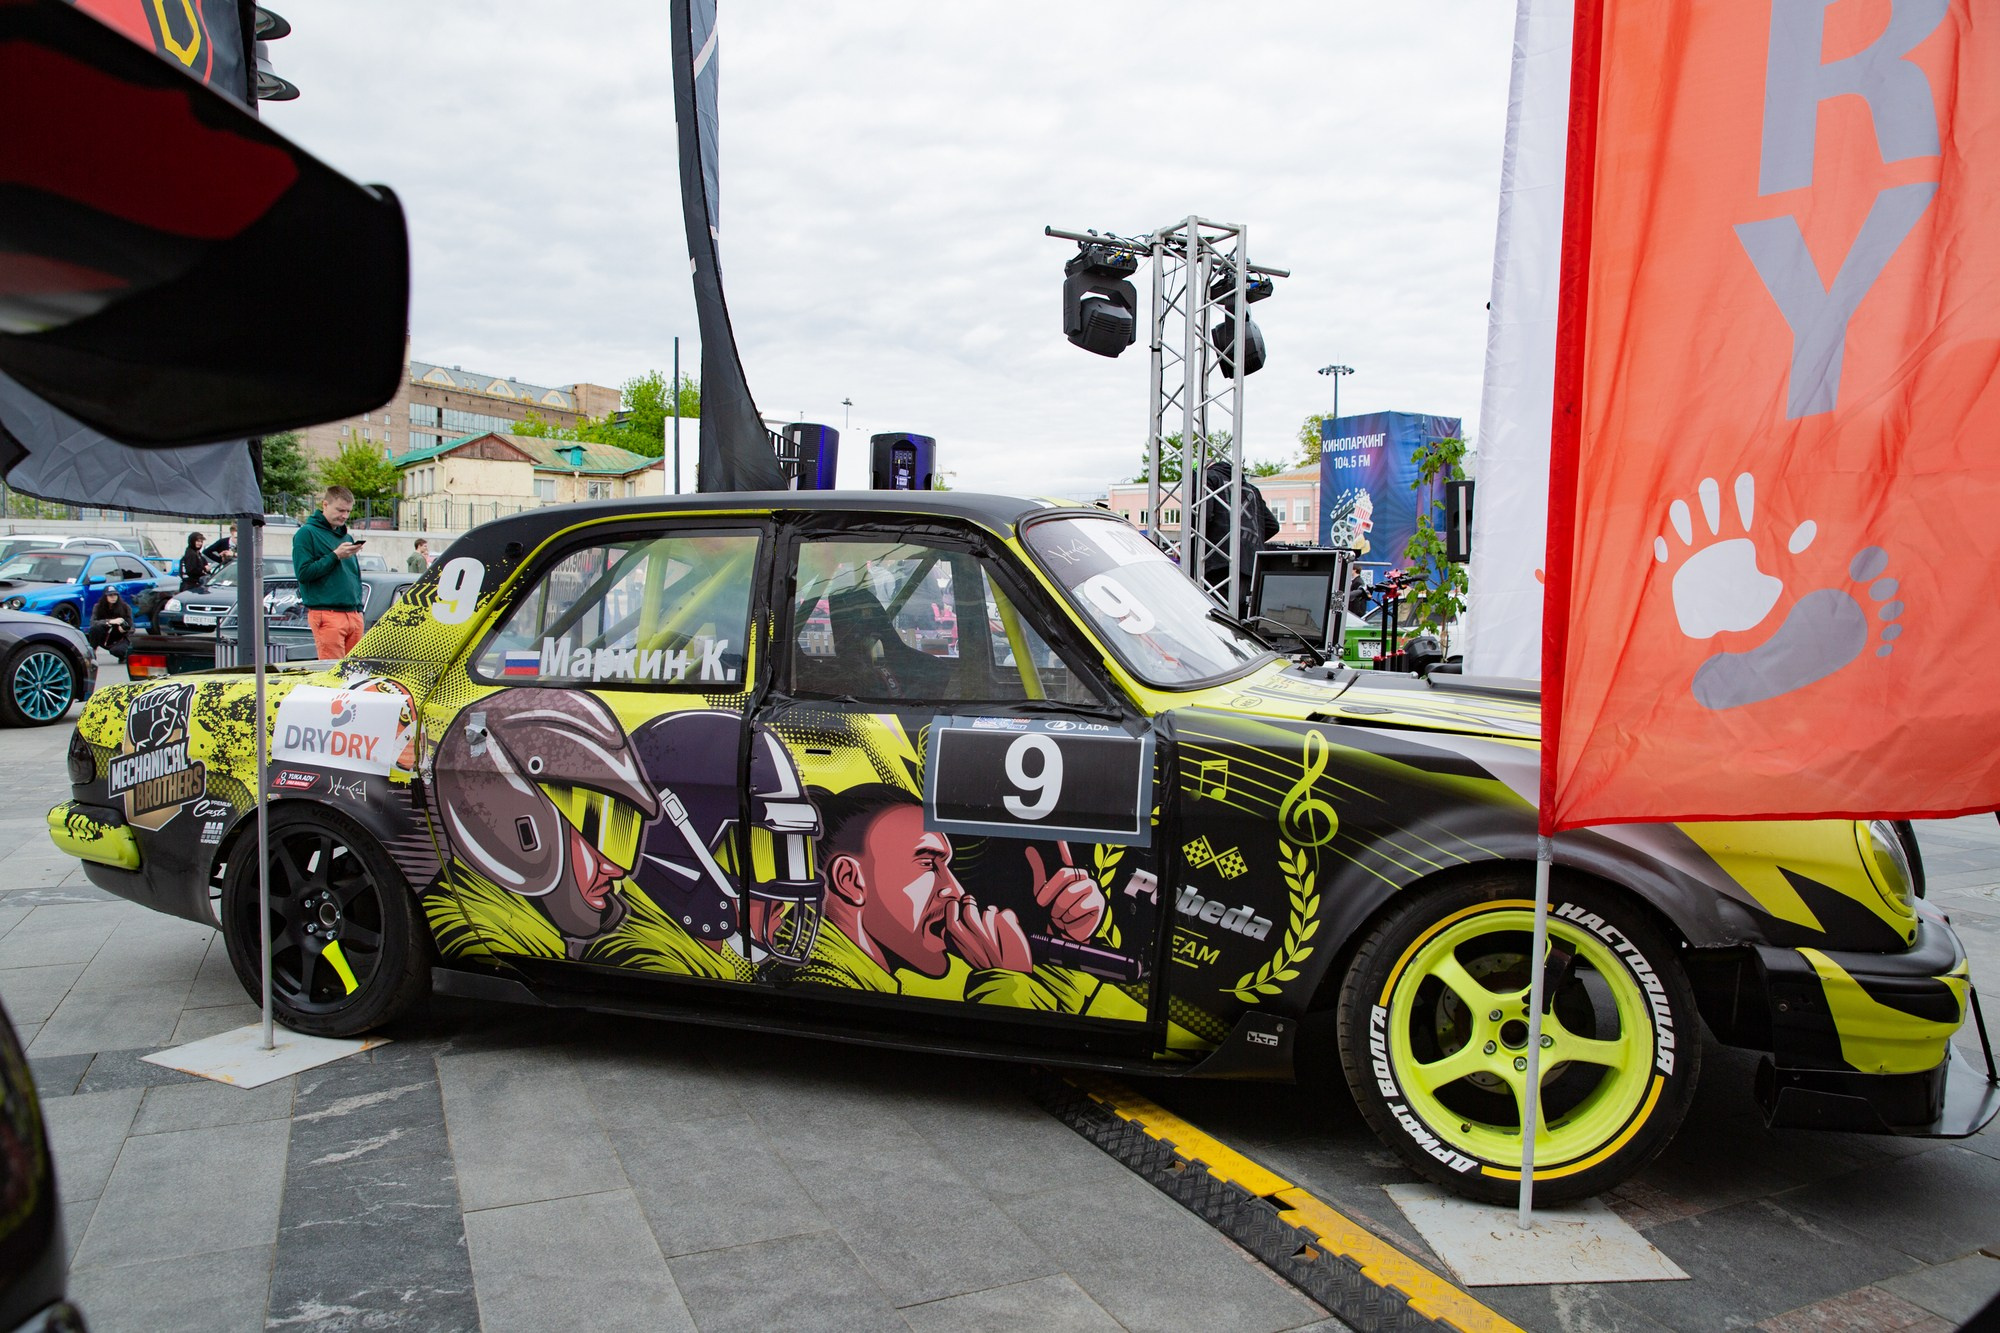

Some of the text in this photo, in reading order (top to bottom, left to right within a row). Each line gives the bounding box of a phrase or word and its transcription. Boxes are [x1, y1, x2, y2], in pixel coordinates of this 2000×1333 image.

[1322, 433, 1386, 453] КИНОПАРКИНГ
[1334, 454, 1371, 469] 104.5 FM
[432, 556, 485, 625] 9
[1084, 574, 1155, 634] 9
[539, 636, 736, 682] Маркин К.
[284, 724, 380, 761] DRYDRY
[1078, 723, 1109, 731] LADA
[111, 742, 188, 792] MECHANICAL
[136, 765, 203, 811] BROTHERS
[302, 774, 316, 782] ADV
[1003, 733, 1064, 820] 9
[1555, 902, 1675, 1076] НАСТОЯЩАЯ
[1369, 1004, 1478, 1173] ДРИФТ ВОЛГА
